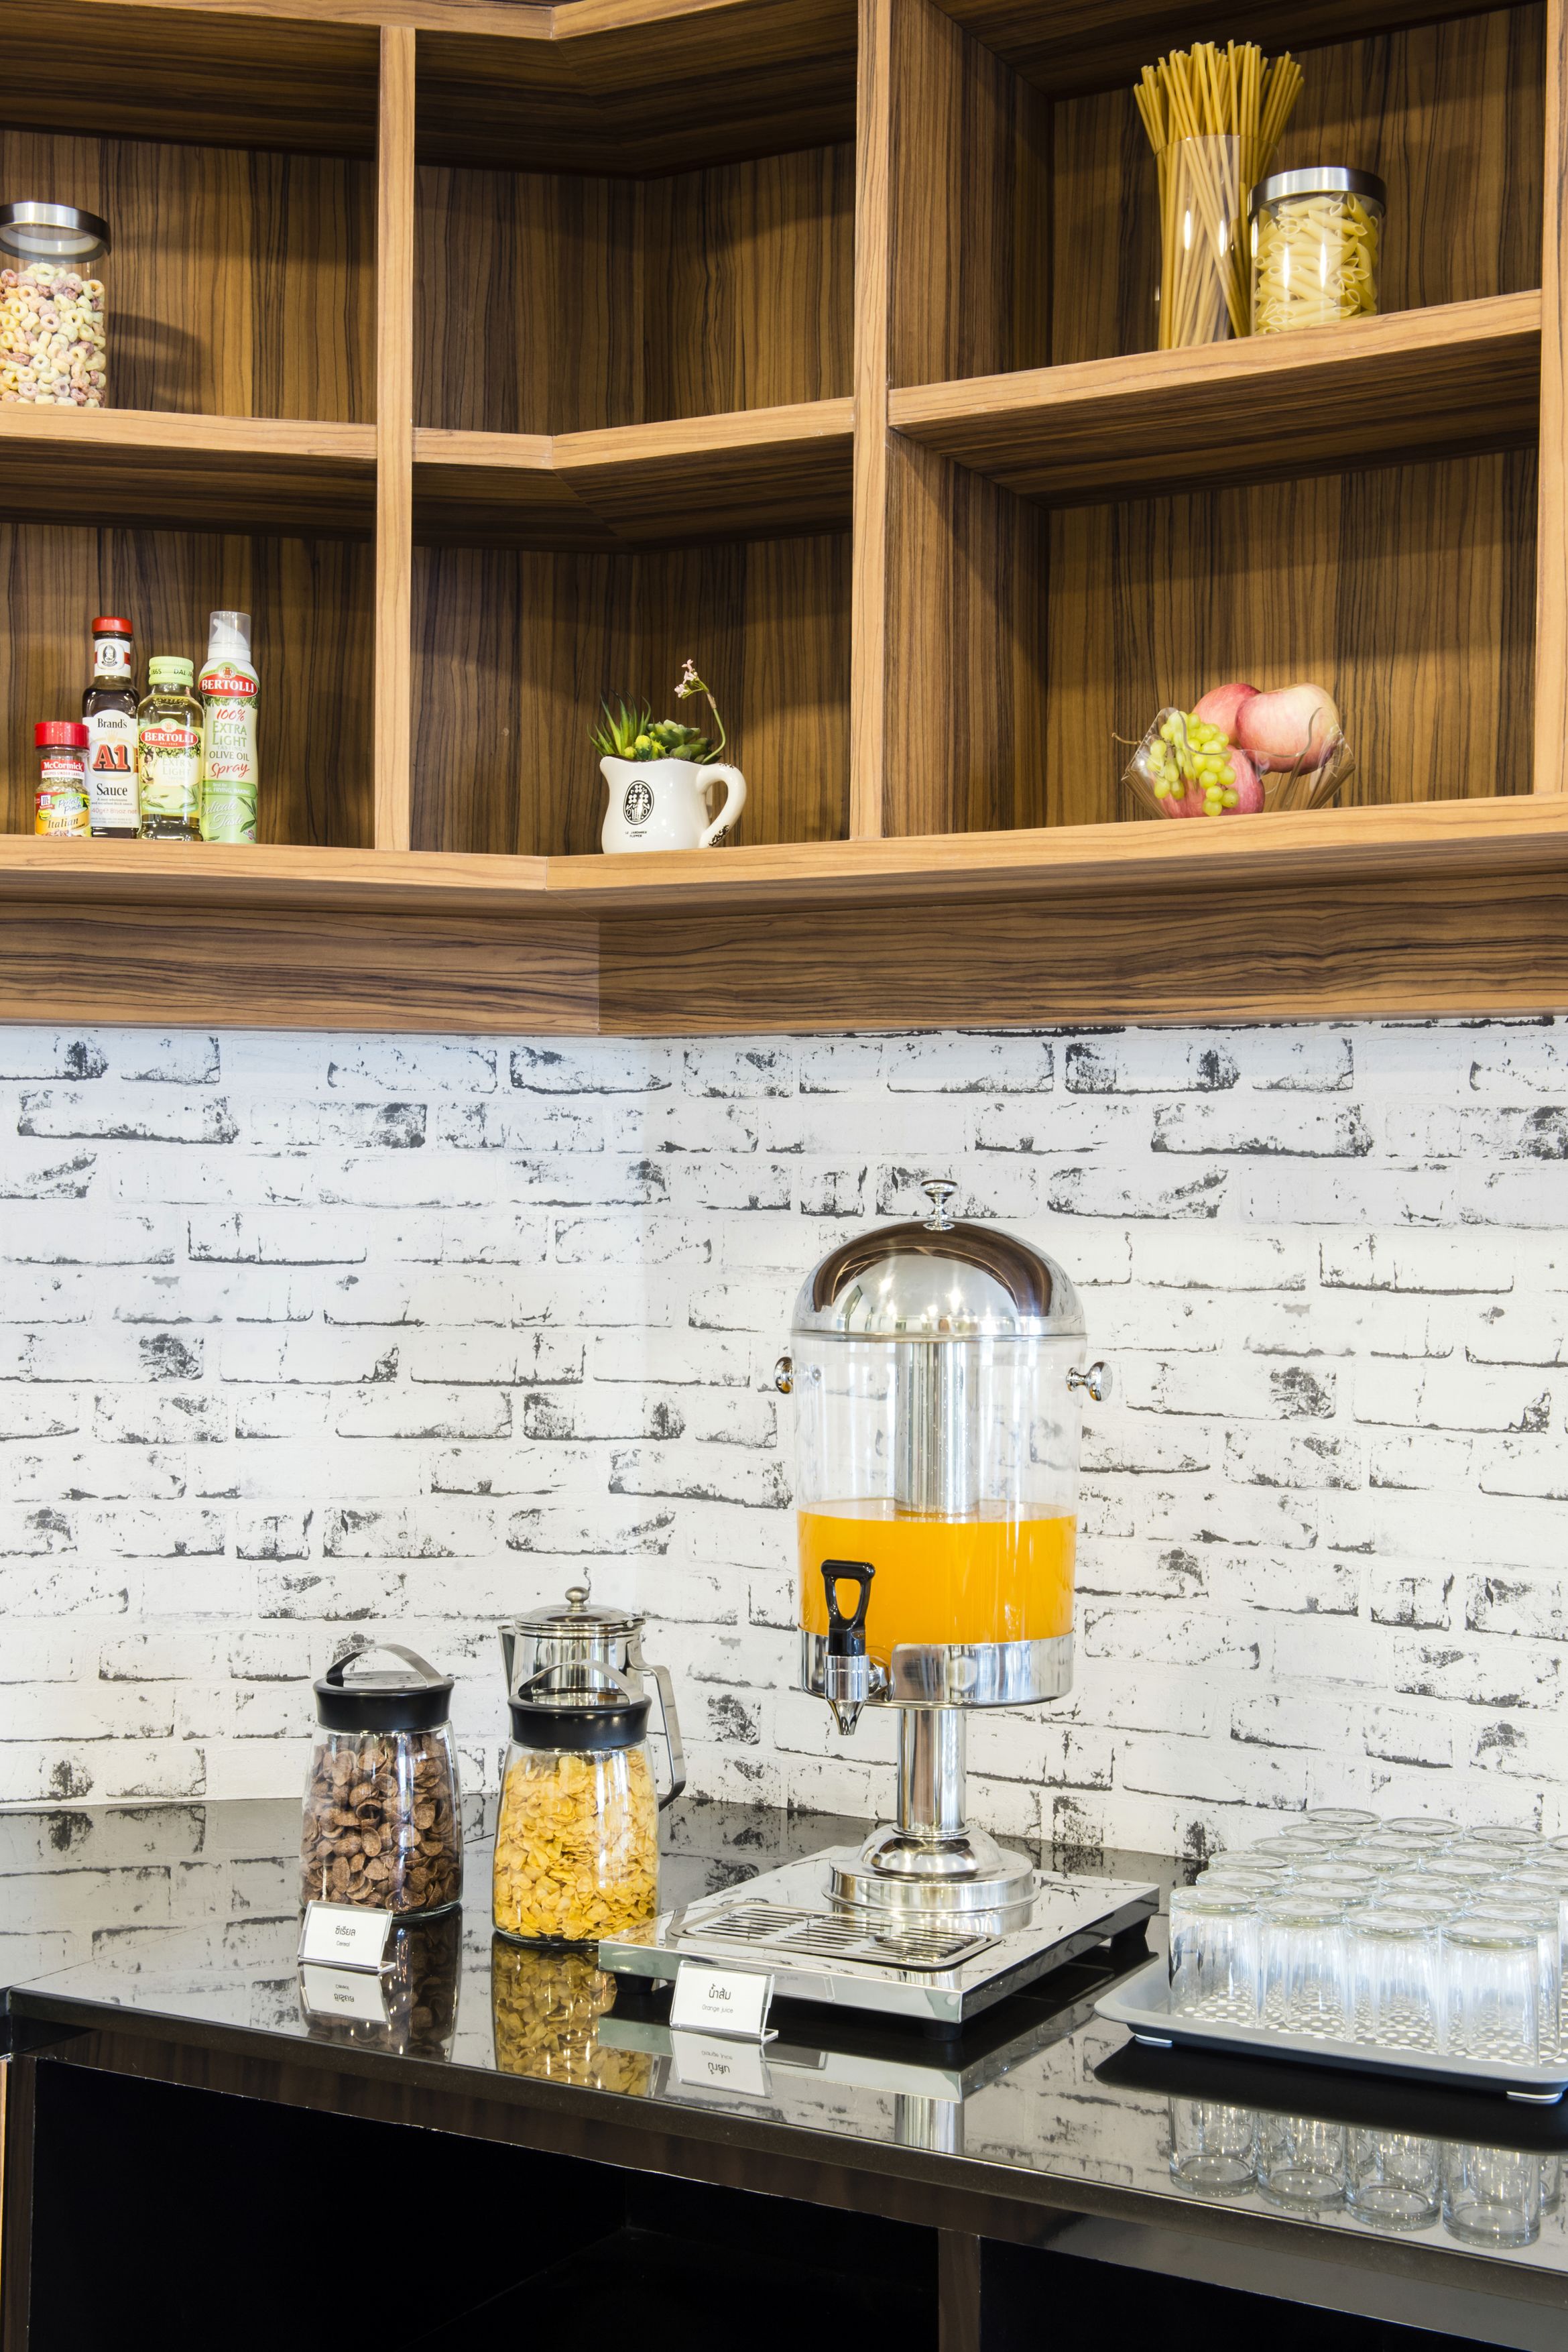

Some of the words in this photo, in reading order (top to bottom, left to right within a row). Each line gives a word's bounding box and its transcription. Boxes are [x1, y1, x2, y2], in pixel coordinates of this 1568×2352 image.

[202, 679, 254, 693] BERTOLLI
[217, 708, 245, 721] 100%
[97, 718, 127, 728] Brand's
[213, 720, 247, 736] EXTRA
[144, 731, 194, 743] BERTOLLI
[213, 732, 247, 747] LIGHT
[93, 744, 131, 772] A1
[209, 751, 235, 759] OLIVE
[237, 752, 249, 762] OIL
[43, 761, 83, 772] McCormick
[210, 762, 250, 779] Spray
[97, 783, 127, 796] Sauce
[58, 797, 79, 807] Perfect
[64, 802, 80, 814] Pinch
[48, 818, 78, 828] Italian
[209, 813, 243, 830] Taste
[335, 1925, 356, 1936] ซีเรียล
[709, 1983, 731, 2000] น้ำส้ม
[702, 2003, 720, 2013] Orange
